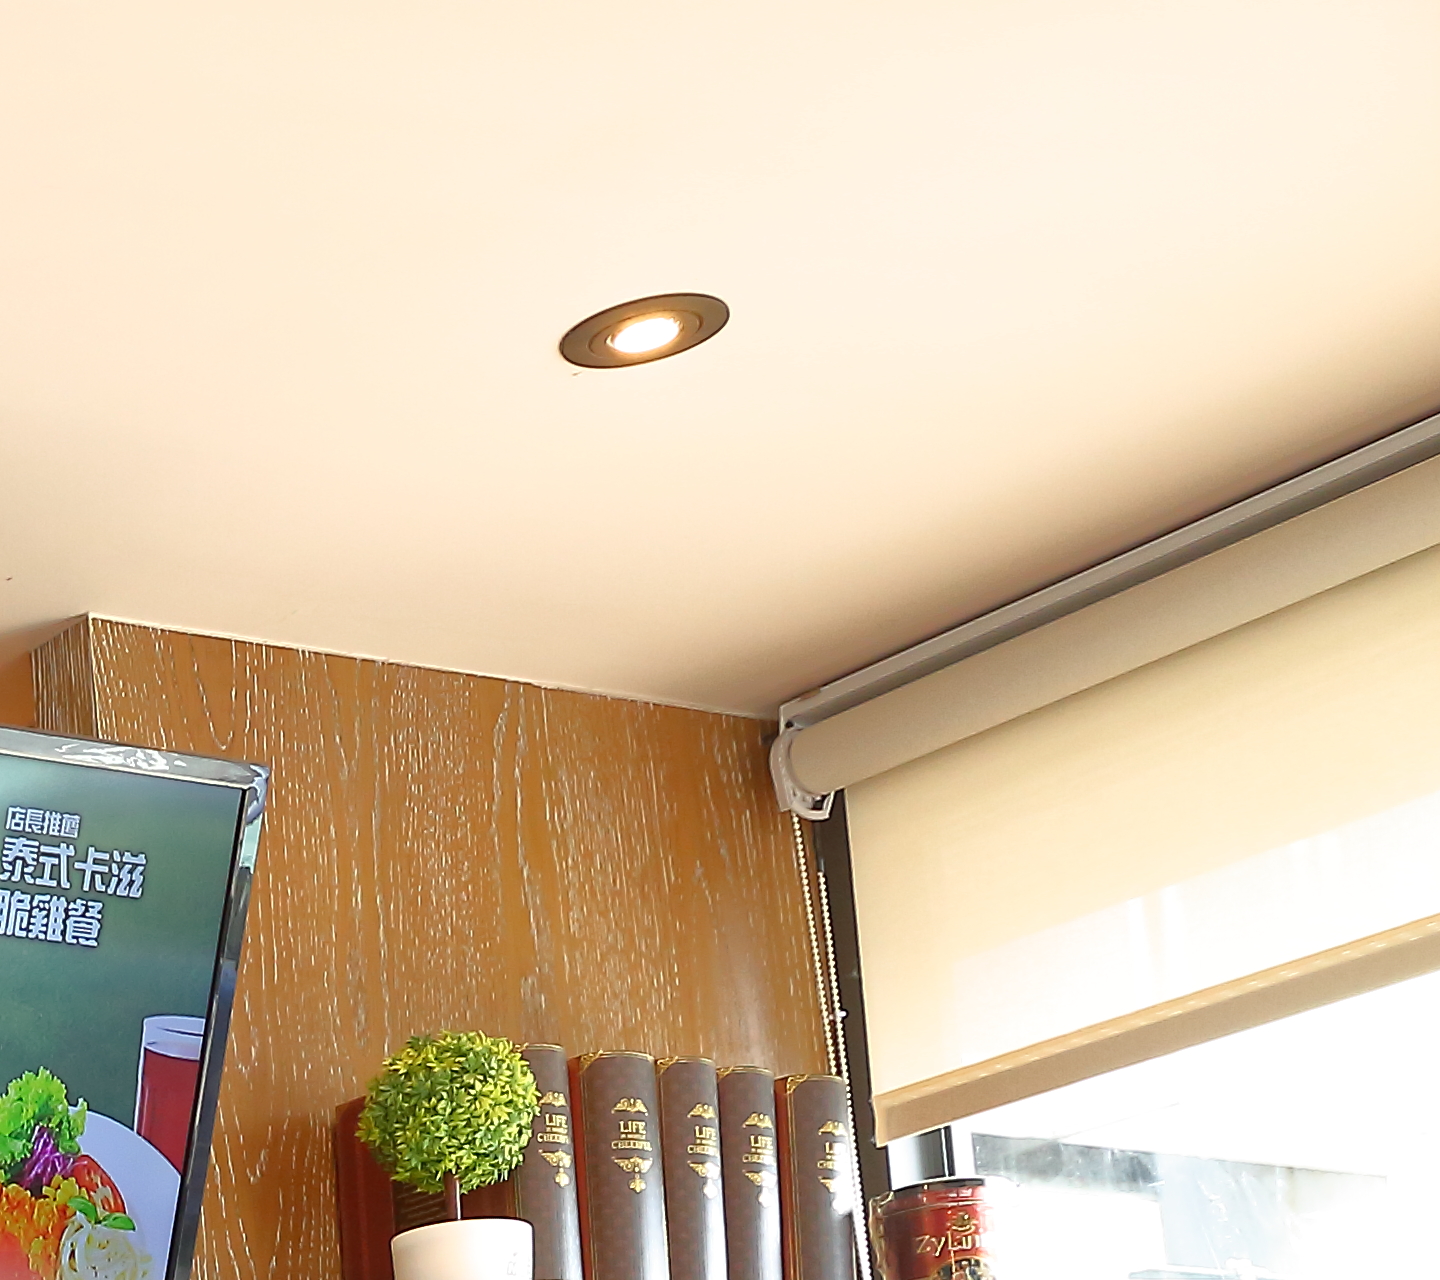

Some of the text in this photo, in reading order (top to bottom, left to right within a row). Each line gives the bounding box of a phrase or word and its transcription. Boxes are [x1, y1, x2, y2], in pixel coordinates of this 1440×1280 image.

[5, 805, 82, 840] 店長推薦
[619, 1120, 647, 1134] LIFE
